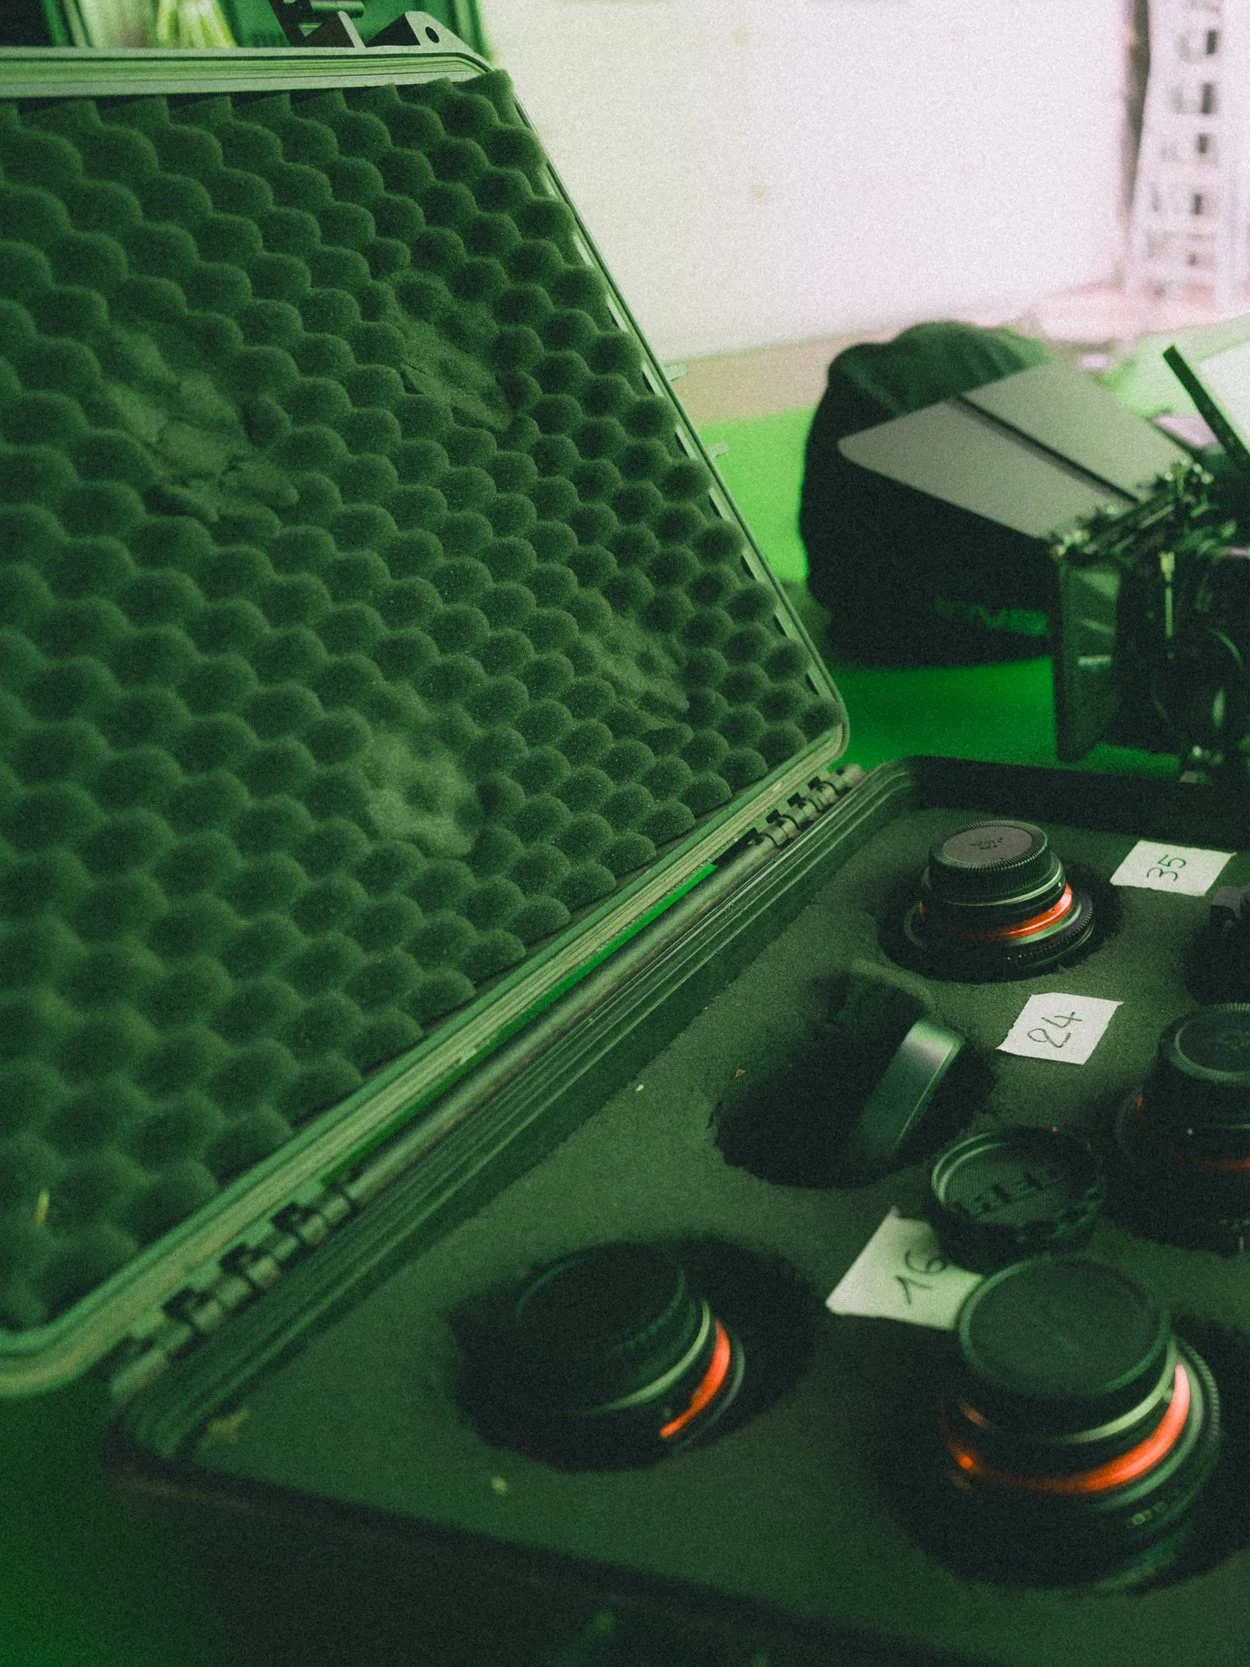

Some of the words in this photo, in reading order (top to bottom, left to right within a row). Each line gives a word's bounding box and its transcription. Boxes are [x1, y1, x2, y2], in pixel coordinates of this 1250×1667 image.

[1147, 853, 1188, 882] 35
[1026, 1010, 1083, 1050] 24
[895, 1249, 949, 1305] 16
